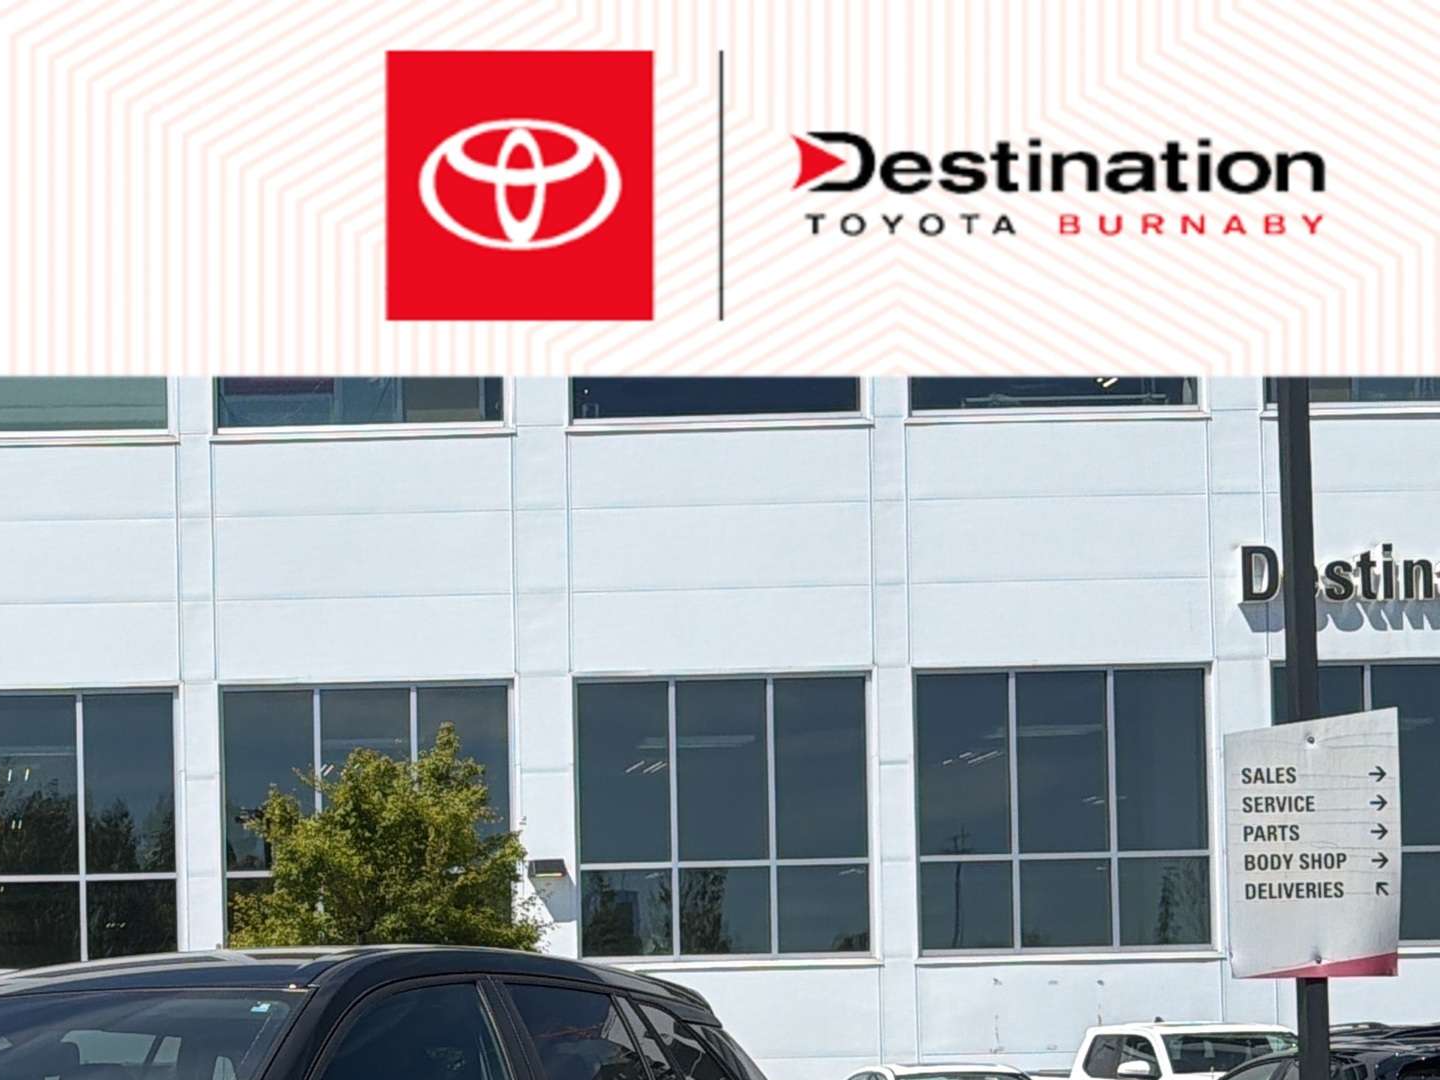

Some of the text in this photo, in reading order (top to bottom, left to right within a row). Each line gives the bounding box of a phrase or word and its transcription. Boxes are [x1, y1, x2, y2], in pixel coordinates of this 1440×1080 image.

[1240, 542, 1440, 602] Dstin
[1241, 766, 1297, 785] SALES
[1242, 795, 1316, 813] SERVICE
[1243, 824, 1300, 842] PARTS
[1244, 852, 1347, 871] BODY SHOP
[1245, 881, 1344, 900] DELIVERIES
